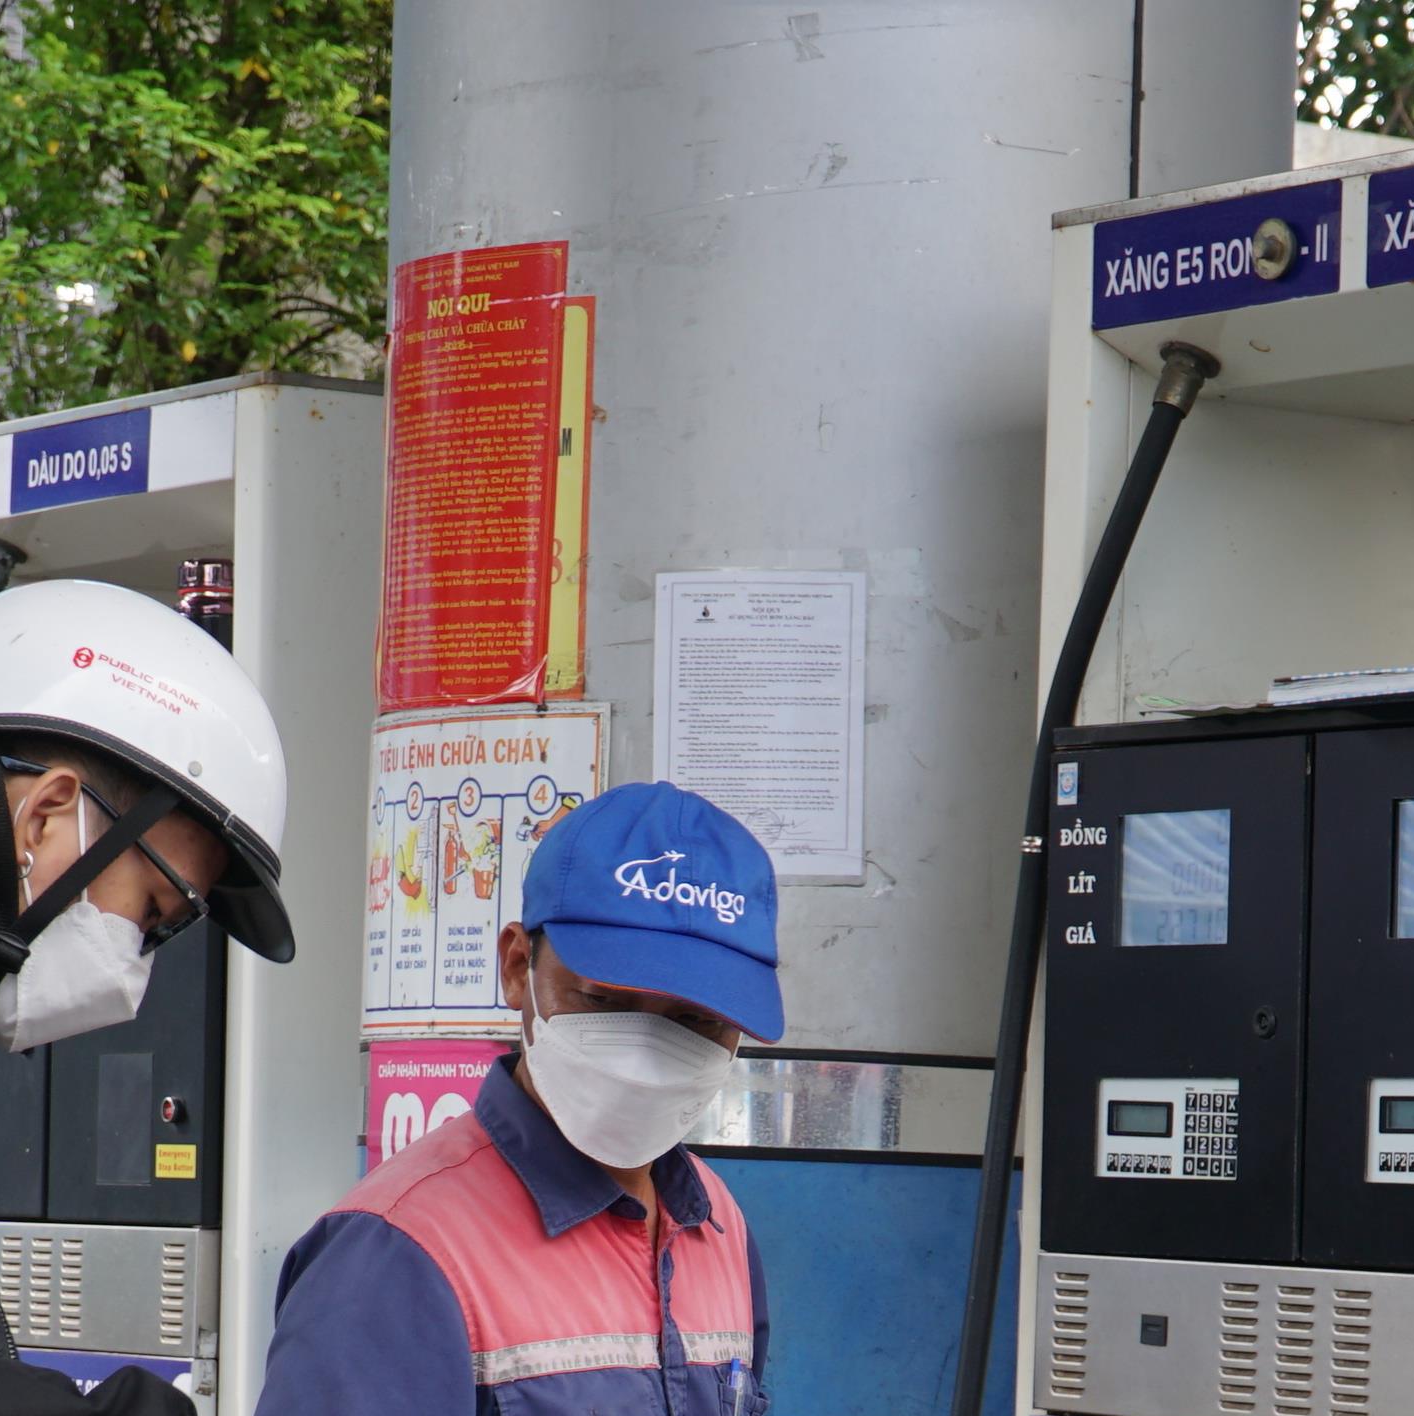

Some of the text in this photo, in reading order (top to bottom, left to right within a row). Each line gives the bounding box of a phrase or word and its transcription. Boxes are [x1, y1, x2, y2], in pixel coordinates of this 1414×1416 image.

[1104, 249, 1169, 297] XĂNG
[1175, 246, 1204, 286] E5
[427, 293, 491, 321] NỘI QUI
[27, 442, 132, 488] DẦU DO 0,05 S
[98, 653, 201, 710] PUBLIC BANK
[111, 673, 183, 715] VIETNAM
[402, 739, 435, 773] LỆNH
[441, 735, 486, 766] CHỮA
[494, 731, 550, 764] CHÁY
[410, 790, 418, 810] 2
[464, 786, 474, 807] 3
[534, 784, 547, 804] 4
[1060, 818, 1107, 846] ĐỒNG
[1068, 871, 1096, 893] LÍT
[1066, 921, 1096, 944] GIÁ
[421, 1063, 456, 1077] THANH
